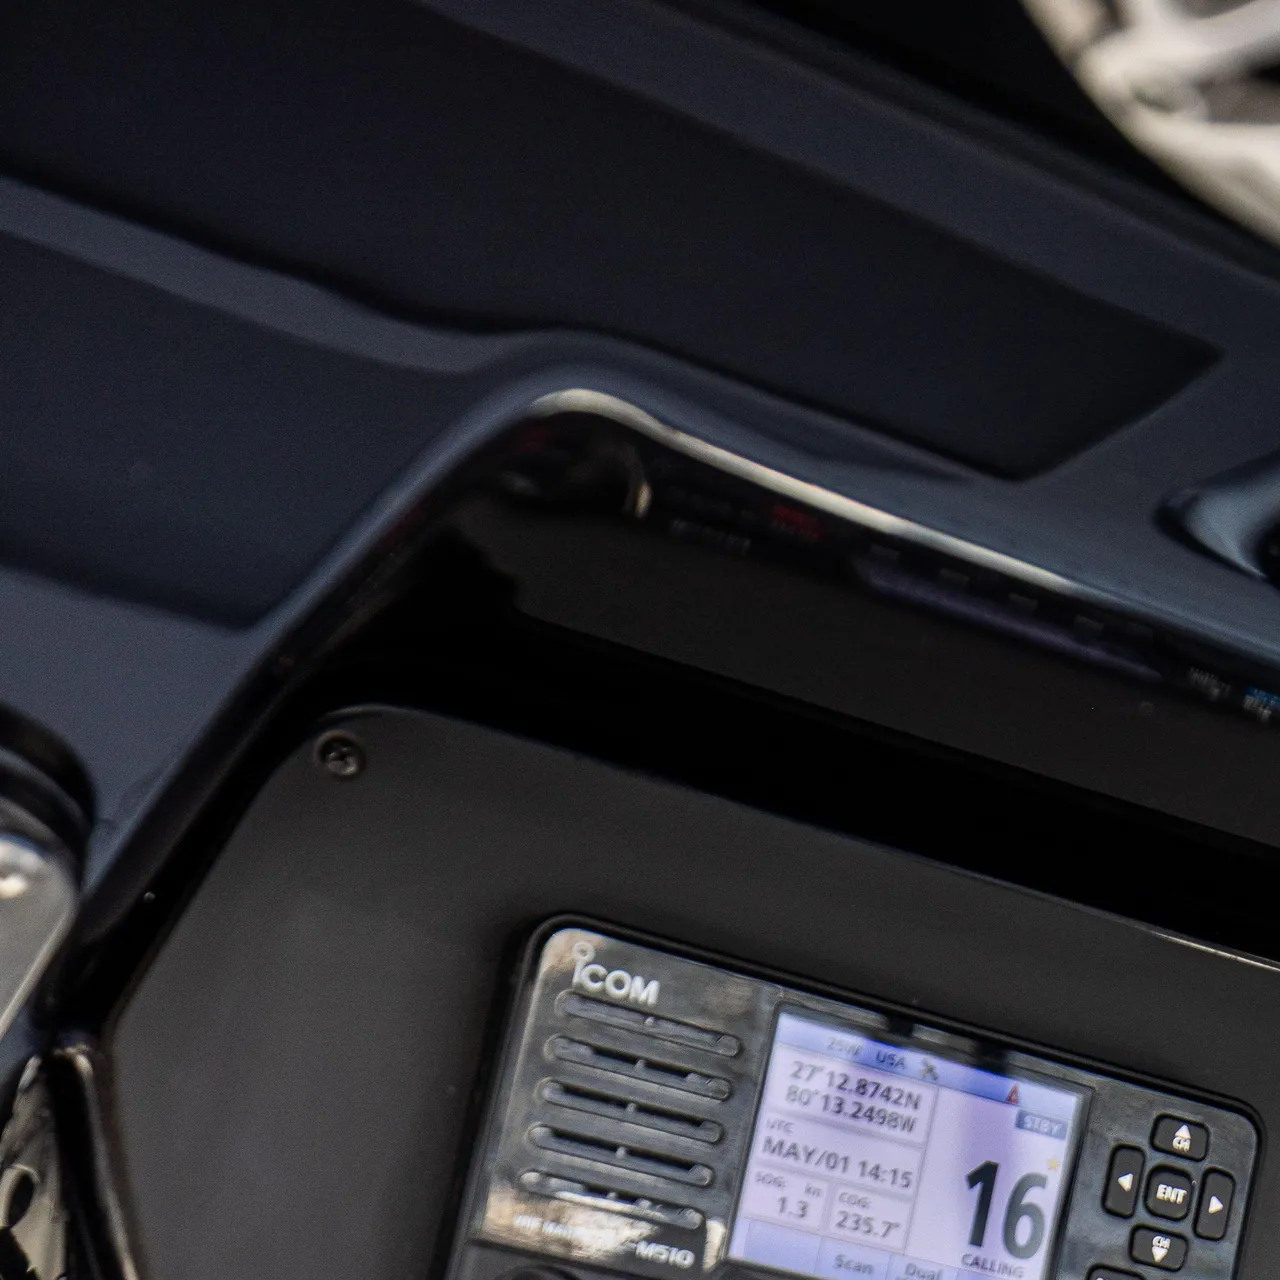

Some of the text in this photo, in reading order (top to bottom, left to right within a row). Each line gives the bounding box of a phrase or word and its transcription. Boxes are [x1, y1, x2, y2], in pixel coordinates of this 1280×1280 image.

[874, 1050, 906, 1069] USA
[766, 1117, 795, 1134] UTC
[1172, 1135, 1192, 1151] CH
[761, 1135, 913, 1189] MAY/01 14:15
[1155, 1183, 1188, 1204] ENT
[777, 1196, 809, 1219] 1.3
[965, 1159, 1049, 1260] 16
[1152, 1235, 1172, 1249] CH
[833, 1253, 874, 1275] Scan
[960, 1252, 1025, 1280] CALLING
